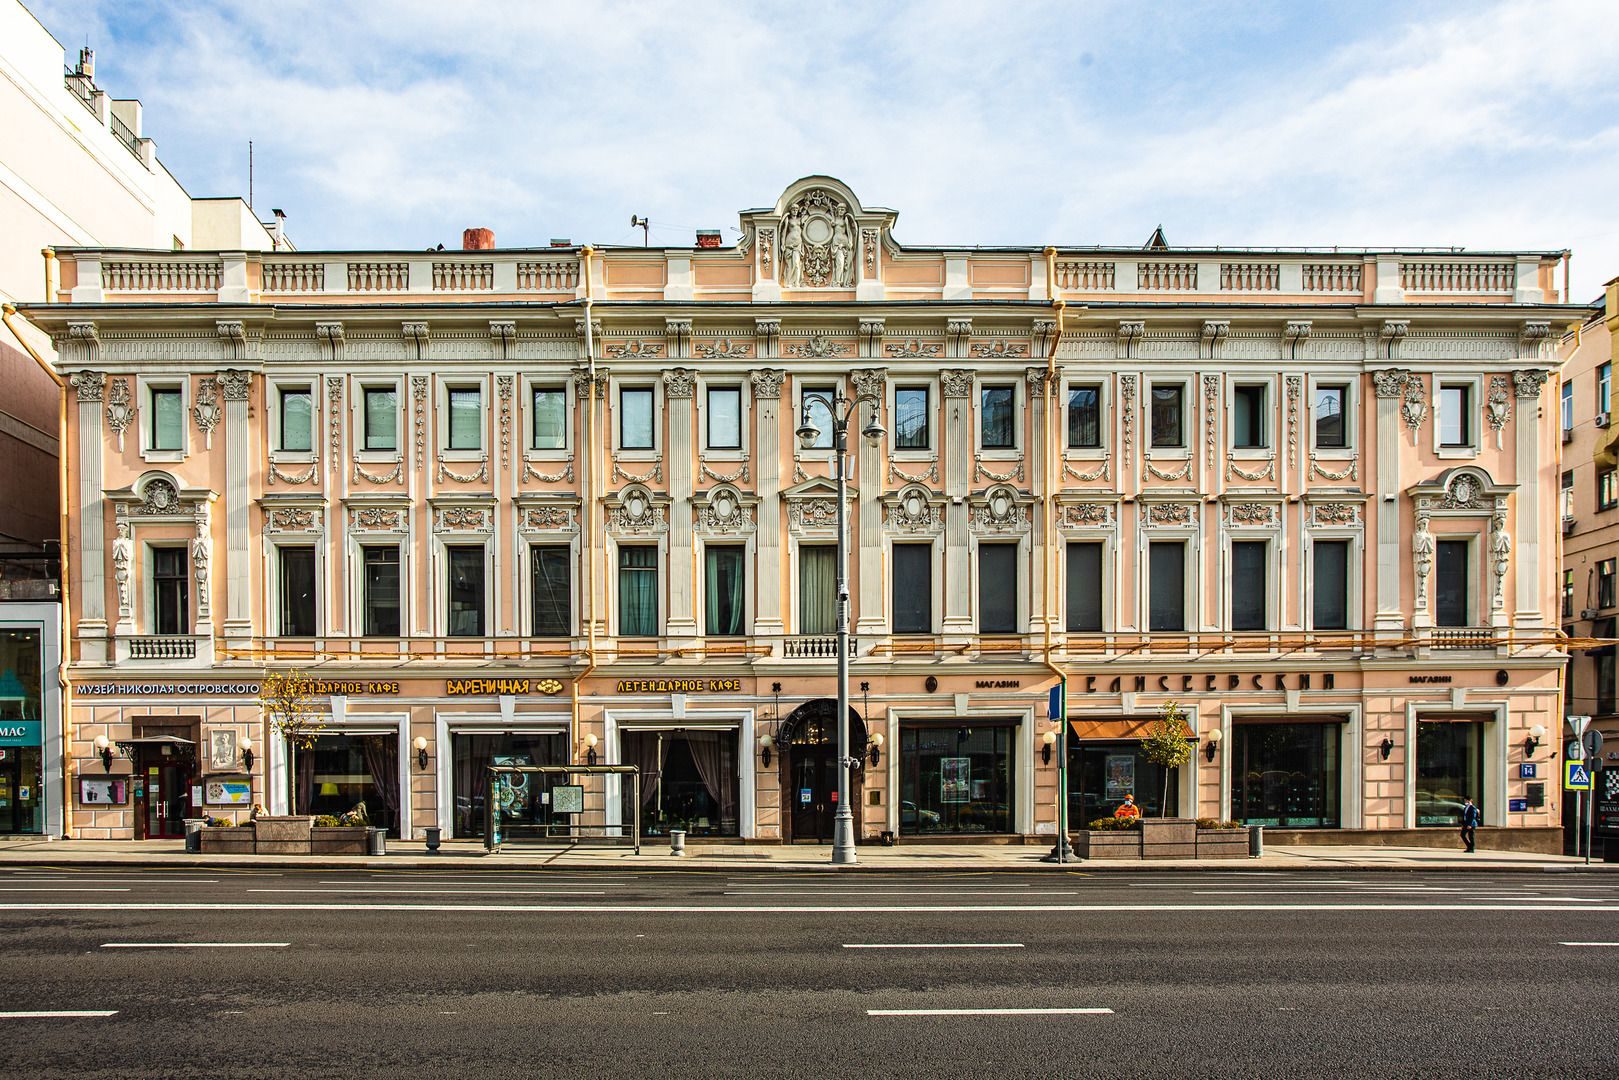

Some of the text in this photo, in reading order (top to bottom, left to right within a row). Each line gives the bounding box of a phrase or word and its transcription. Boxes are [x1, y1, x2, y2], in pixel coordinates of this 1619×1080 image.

[76, 682, 260, 695] МУЗЕЙ НИКОЛАЯ ОСТРОВСКОГО
[368, 682, 399, 693] КАФЕ
[446, 679, 530, 694] ВАРЕНИЧНАЯ
[617, 680, 741, 692] ЛЕГЕНДАРНОЕ КАФЕ
[1524, 767, 1533, 775] 14
